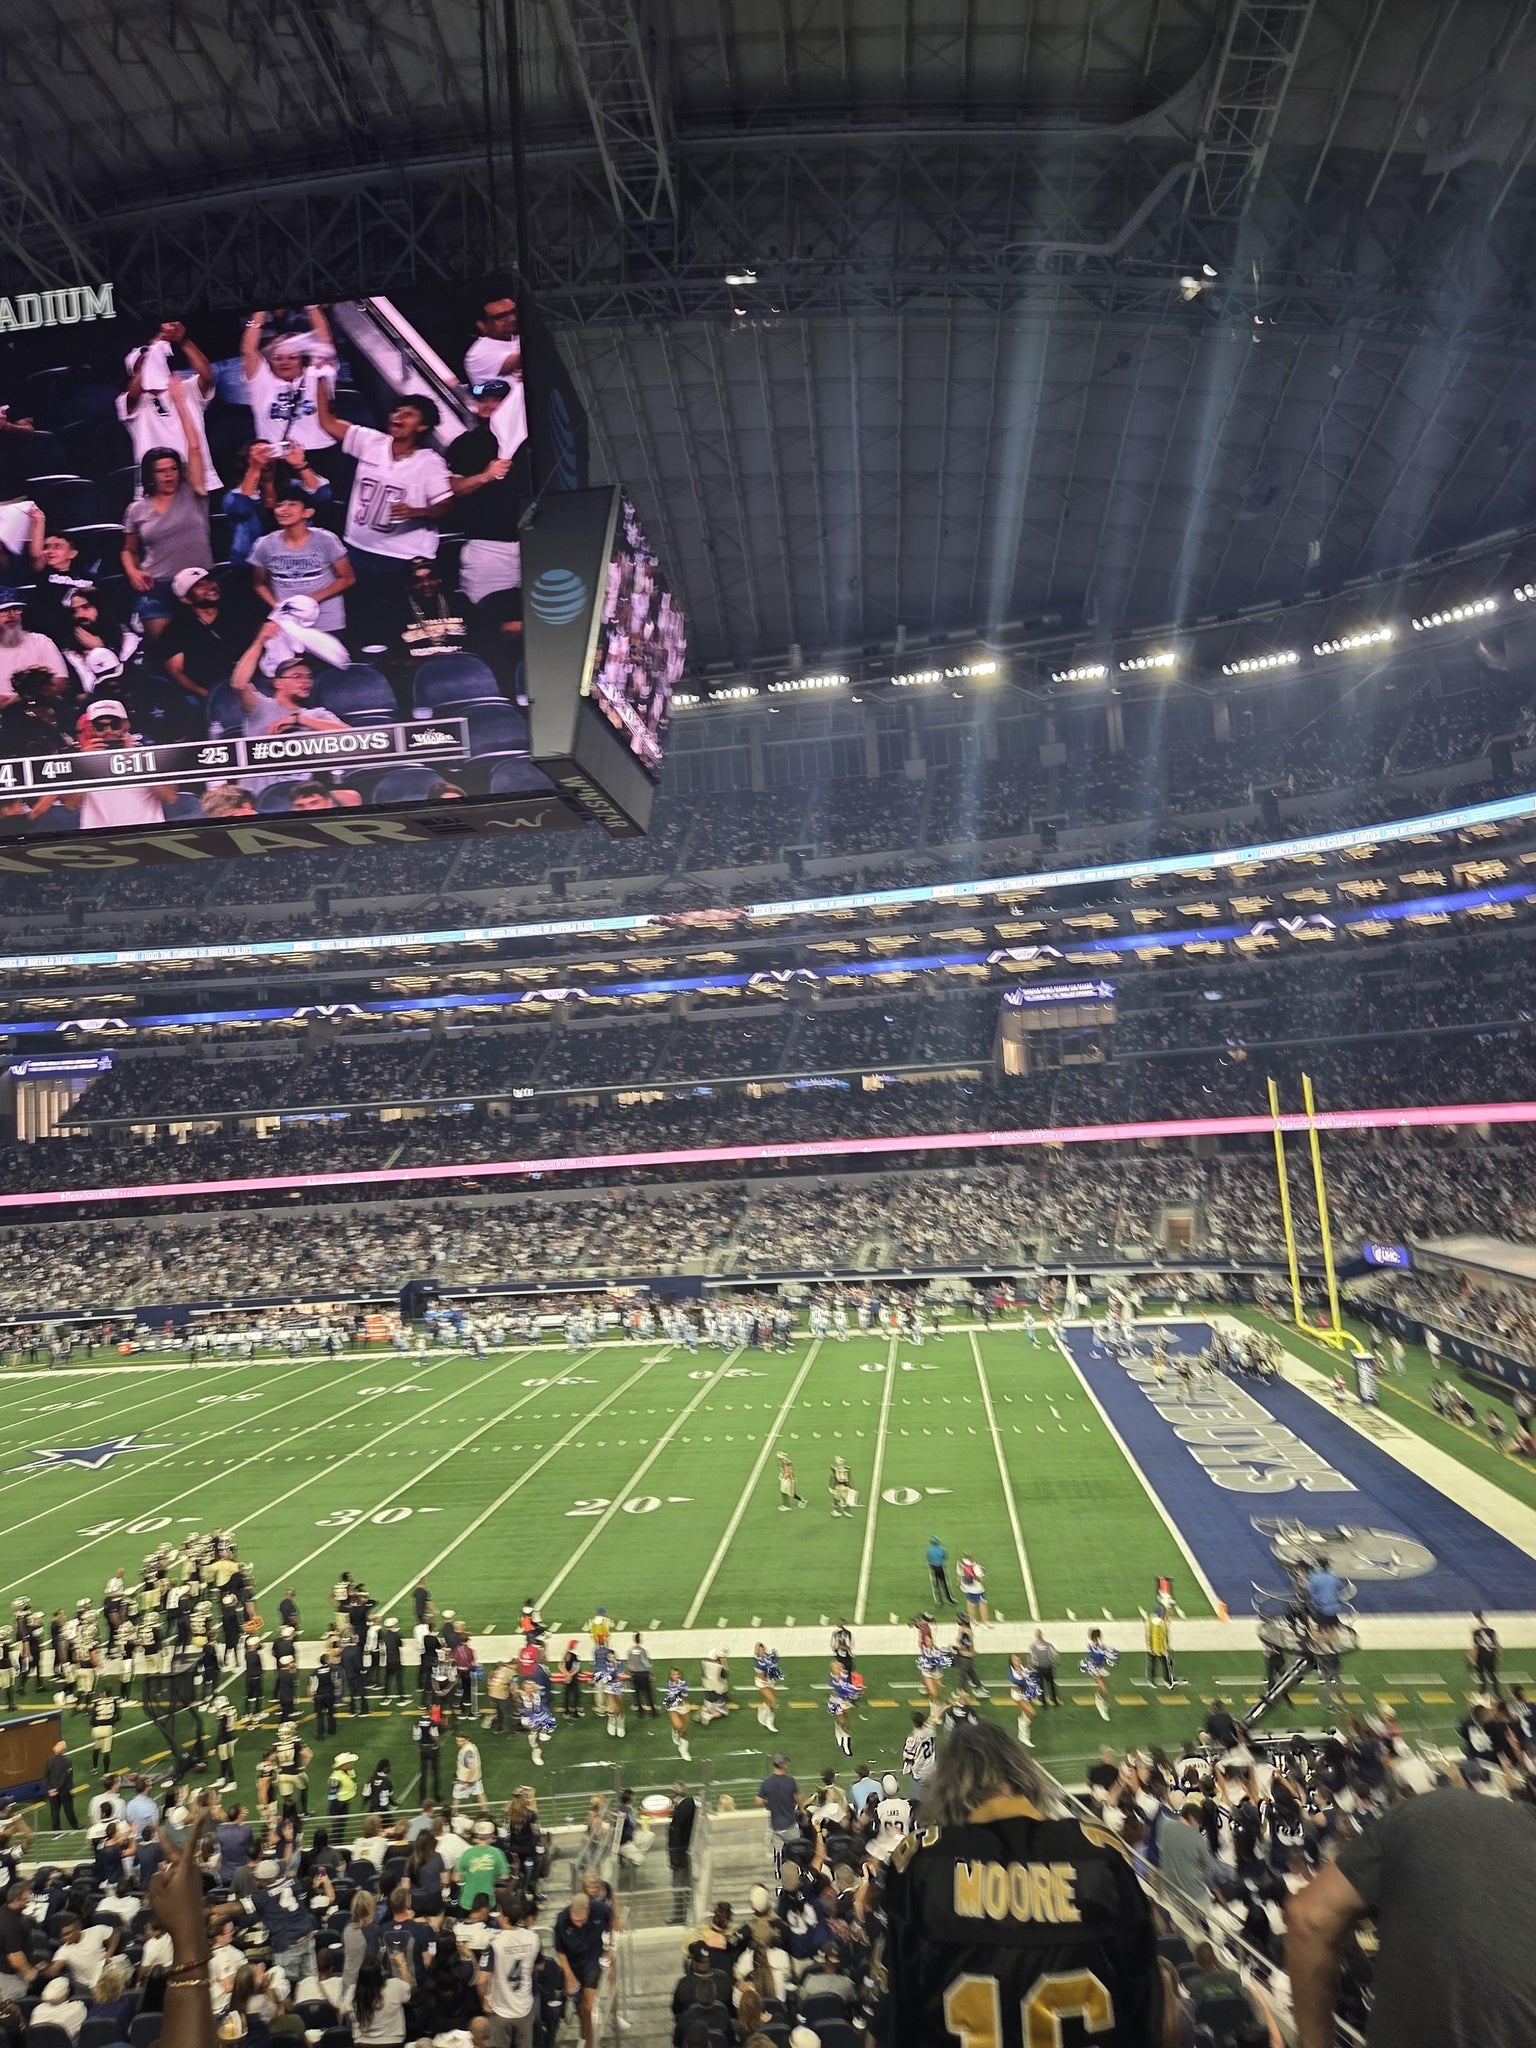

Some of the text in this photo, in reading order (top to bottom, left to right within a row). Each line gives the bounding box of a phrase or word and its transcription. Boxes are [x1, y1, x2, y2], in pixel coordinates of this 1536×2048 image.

[41, 760, 73, 779] 4TH
[110, 751, 157, 775] 6:11
[252, 732, 390, 760] #COWBOYS
[313, 1506, 414, 1527] 30
[564, 1495, 663, 1516] 20
[75, 1516, 174, 1537] 40
[953, 1857, 1083, 1924] MOORE
[506, 1959, 523, 1993] 4
